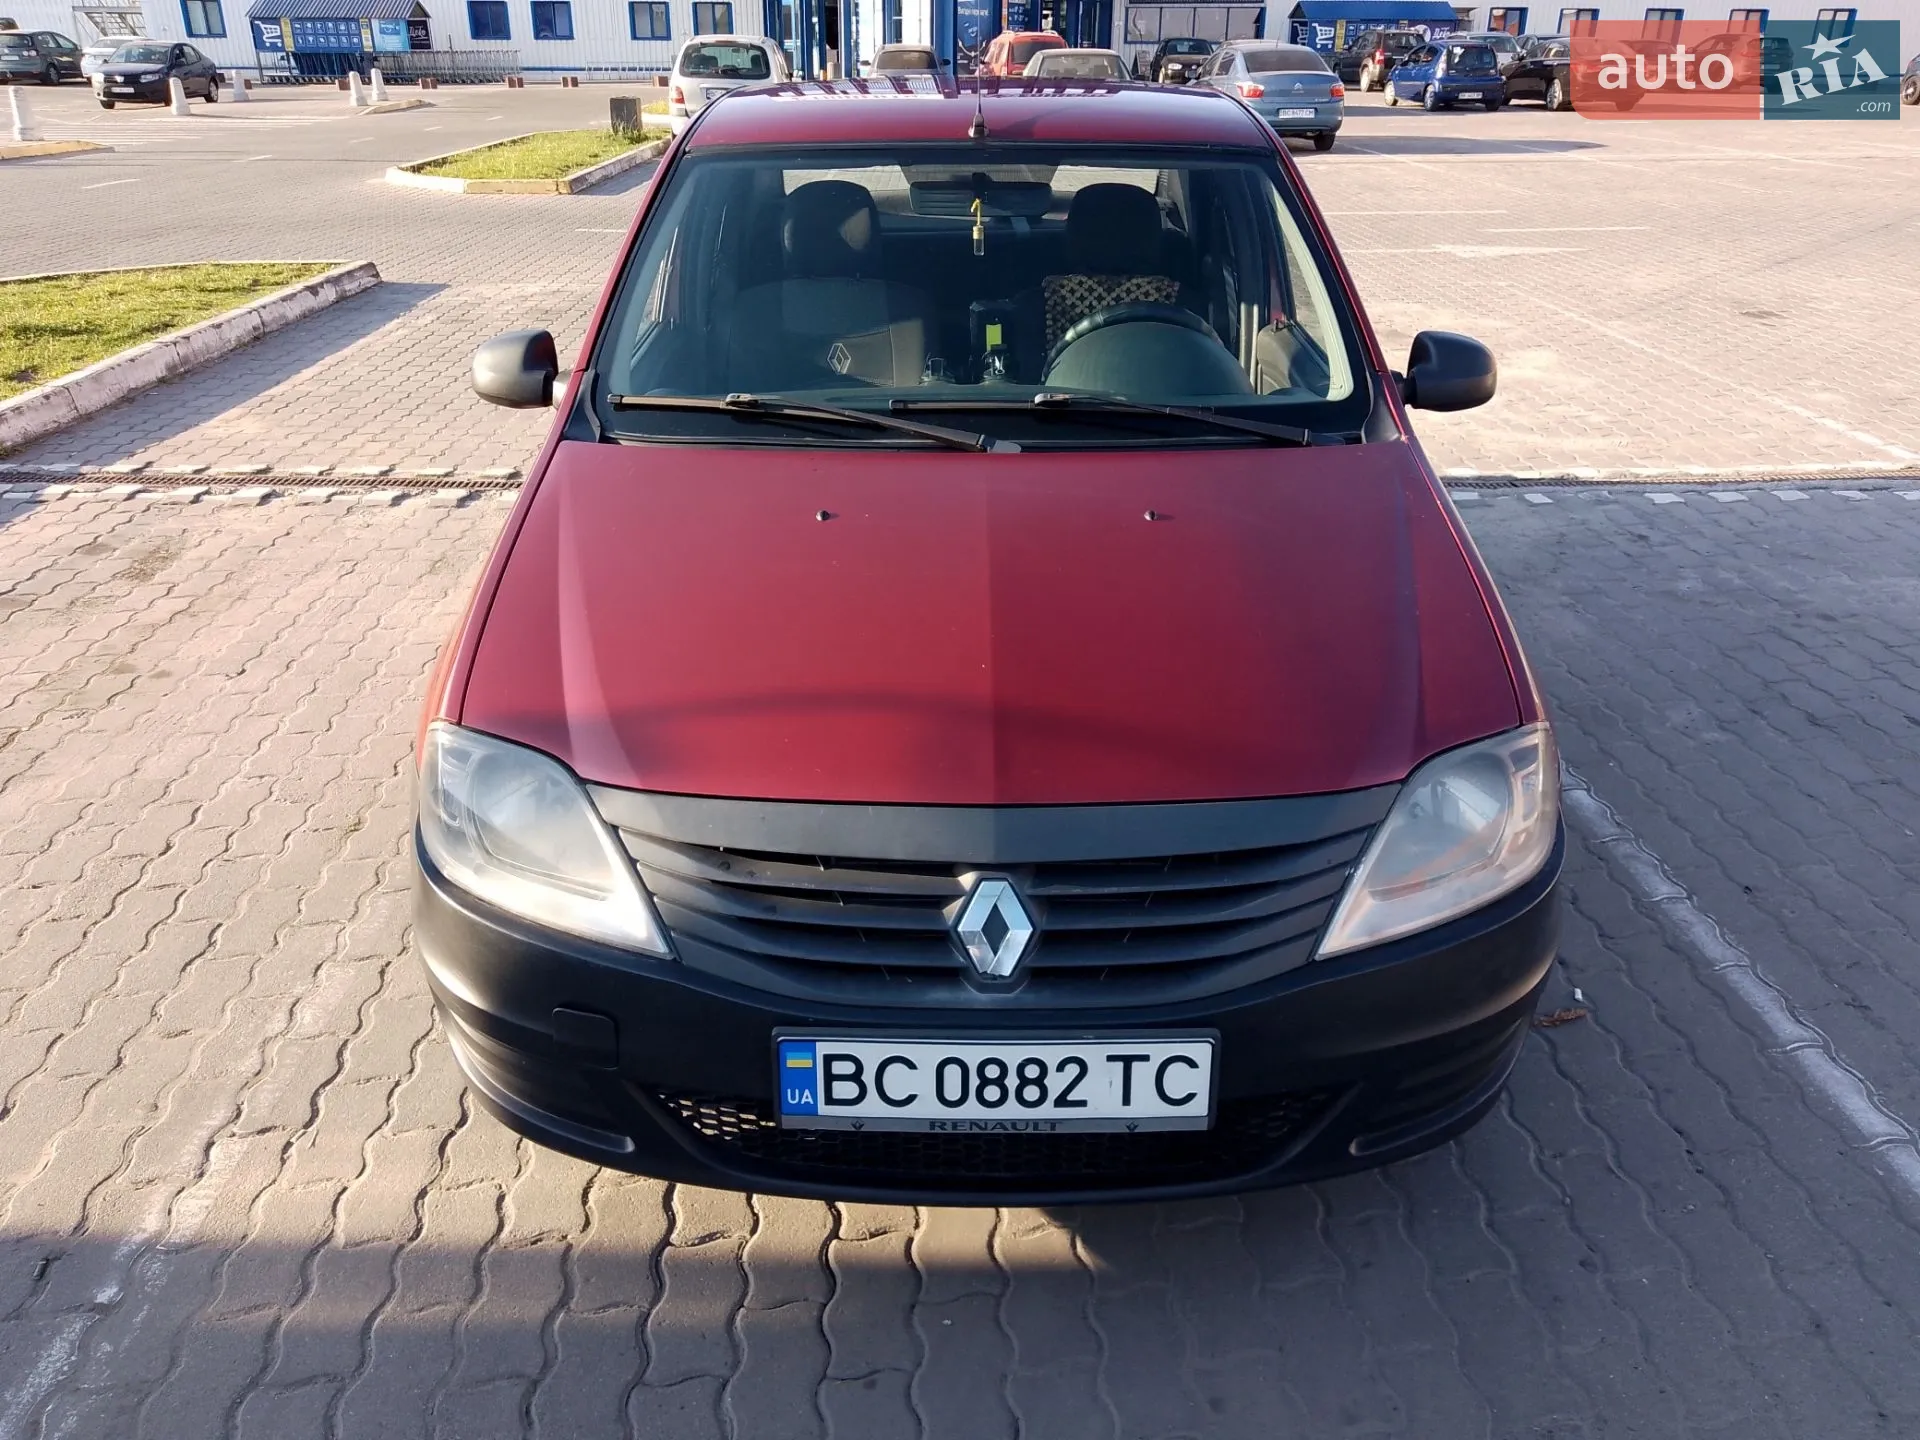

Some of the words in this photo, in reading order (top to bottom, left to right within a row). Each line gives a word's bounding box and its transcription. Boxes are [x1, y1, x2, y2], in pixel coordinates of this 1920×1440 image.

[823, 1053, 919, 1108] BC
[935, 1056, 1089, 1109] 0882
[1106, 1054, 1200, 1107] TC
[787, 1088, 814, 1104] UA
[929, 1120, 1062, 1131] RENAULT
